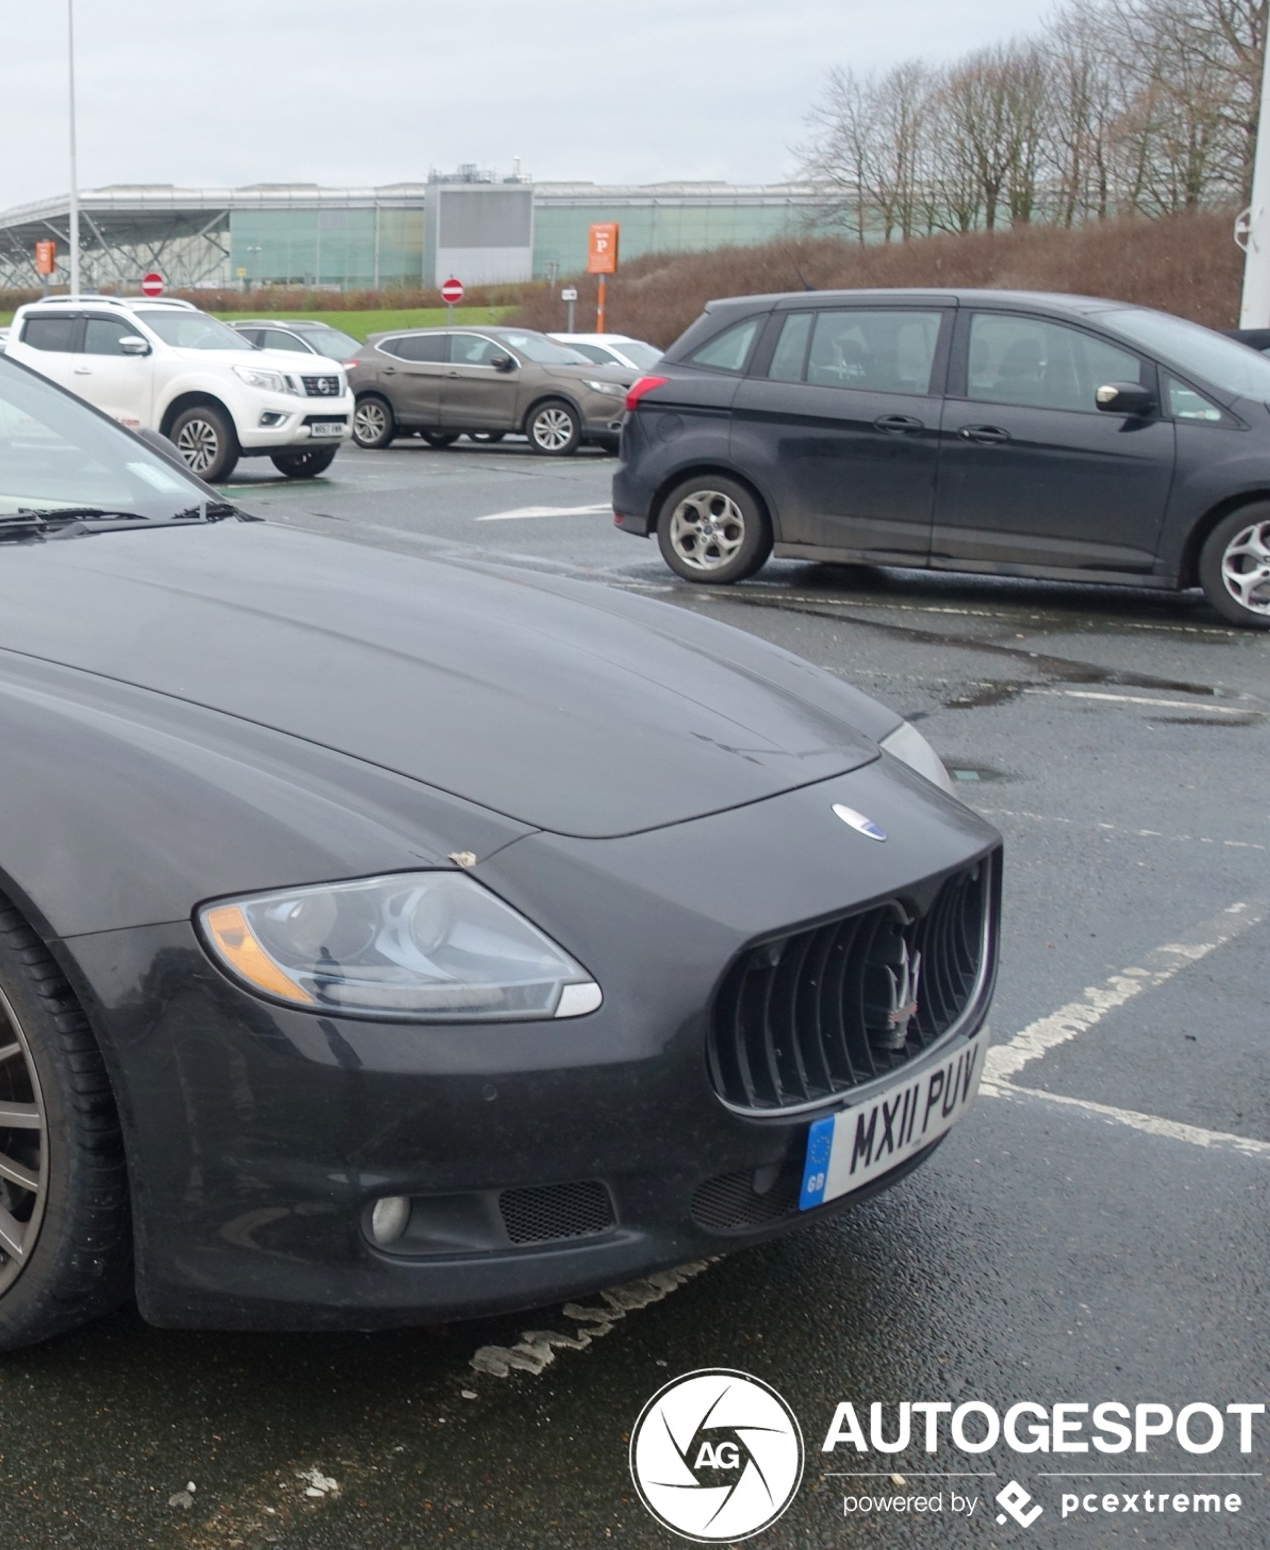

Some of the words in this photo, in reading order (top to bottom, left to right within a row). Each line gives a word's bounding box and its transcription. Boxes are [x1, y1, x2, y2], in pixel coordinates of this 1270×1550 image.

[849, 1083, 920, 1175] MX11
[922, 1042, 979, 1135] PUV
[807, 1172, 825, 1193] GB
